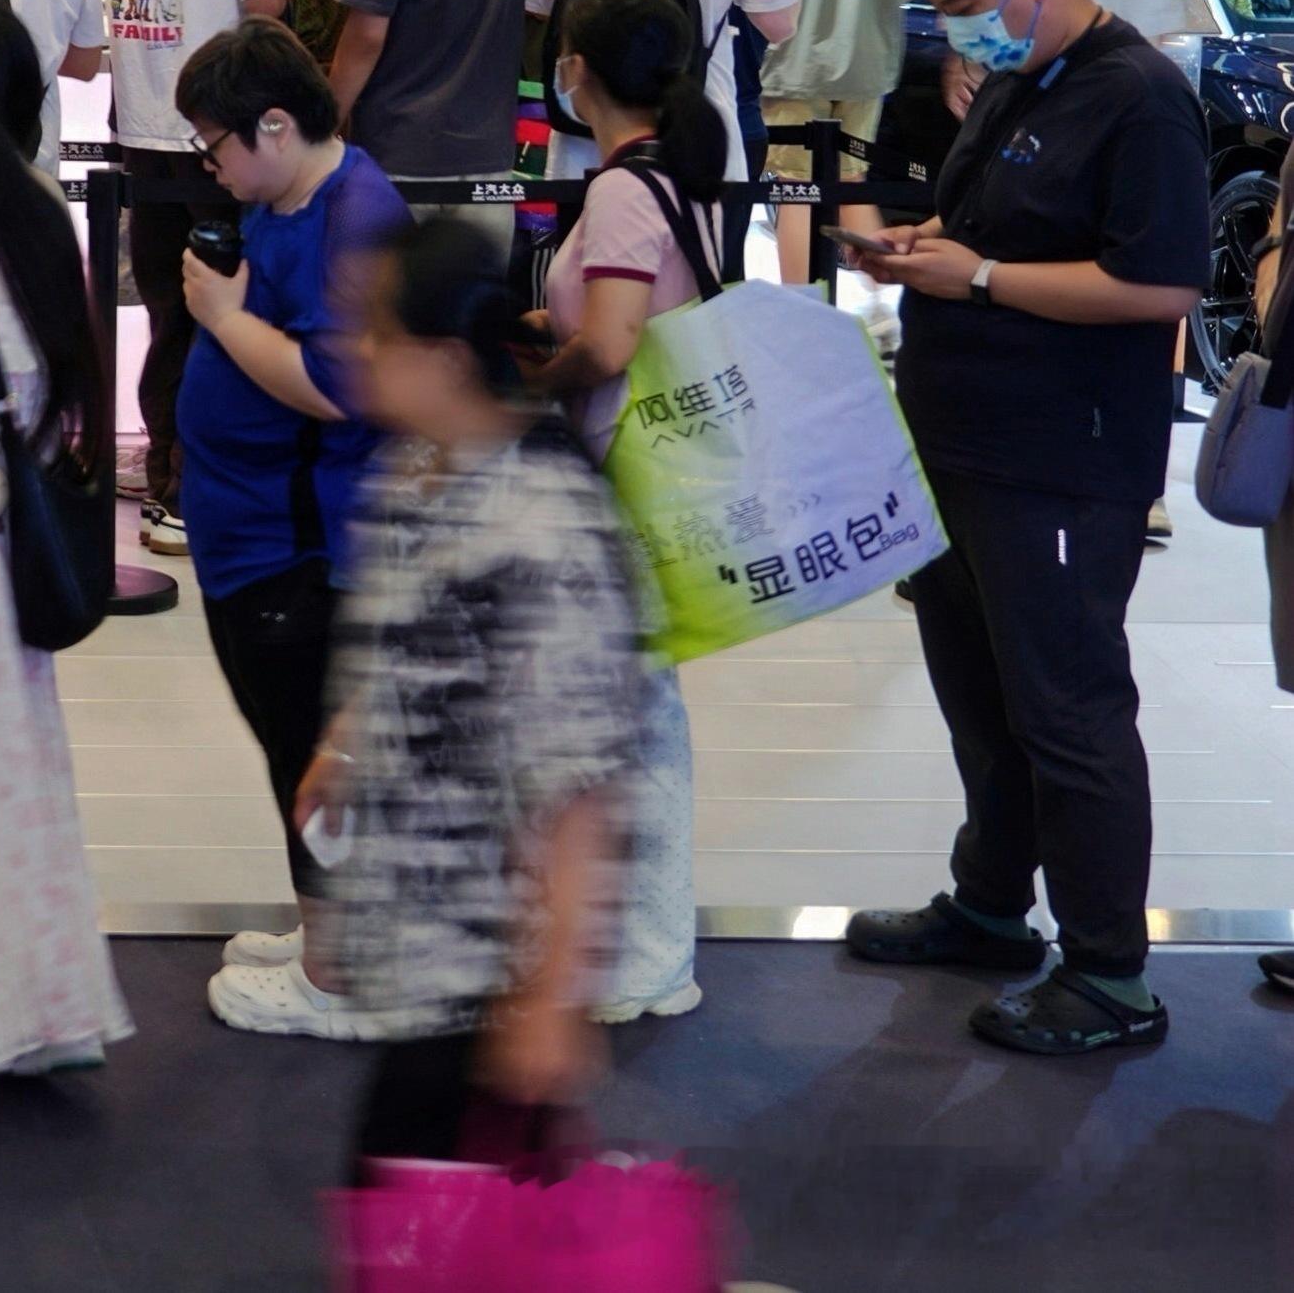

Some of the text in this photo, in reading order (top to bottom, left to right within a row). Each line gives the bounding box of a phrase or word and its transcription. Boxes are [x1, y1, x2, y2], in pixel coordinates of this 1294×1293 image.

[471, 183, 525, 195] 上汽大众
[769, 184, 821, 195] 上汽大众
[635, 364, 750, 430] 阿维塔
[879, 523, 920, 553] Bag
